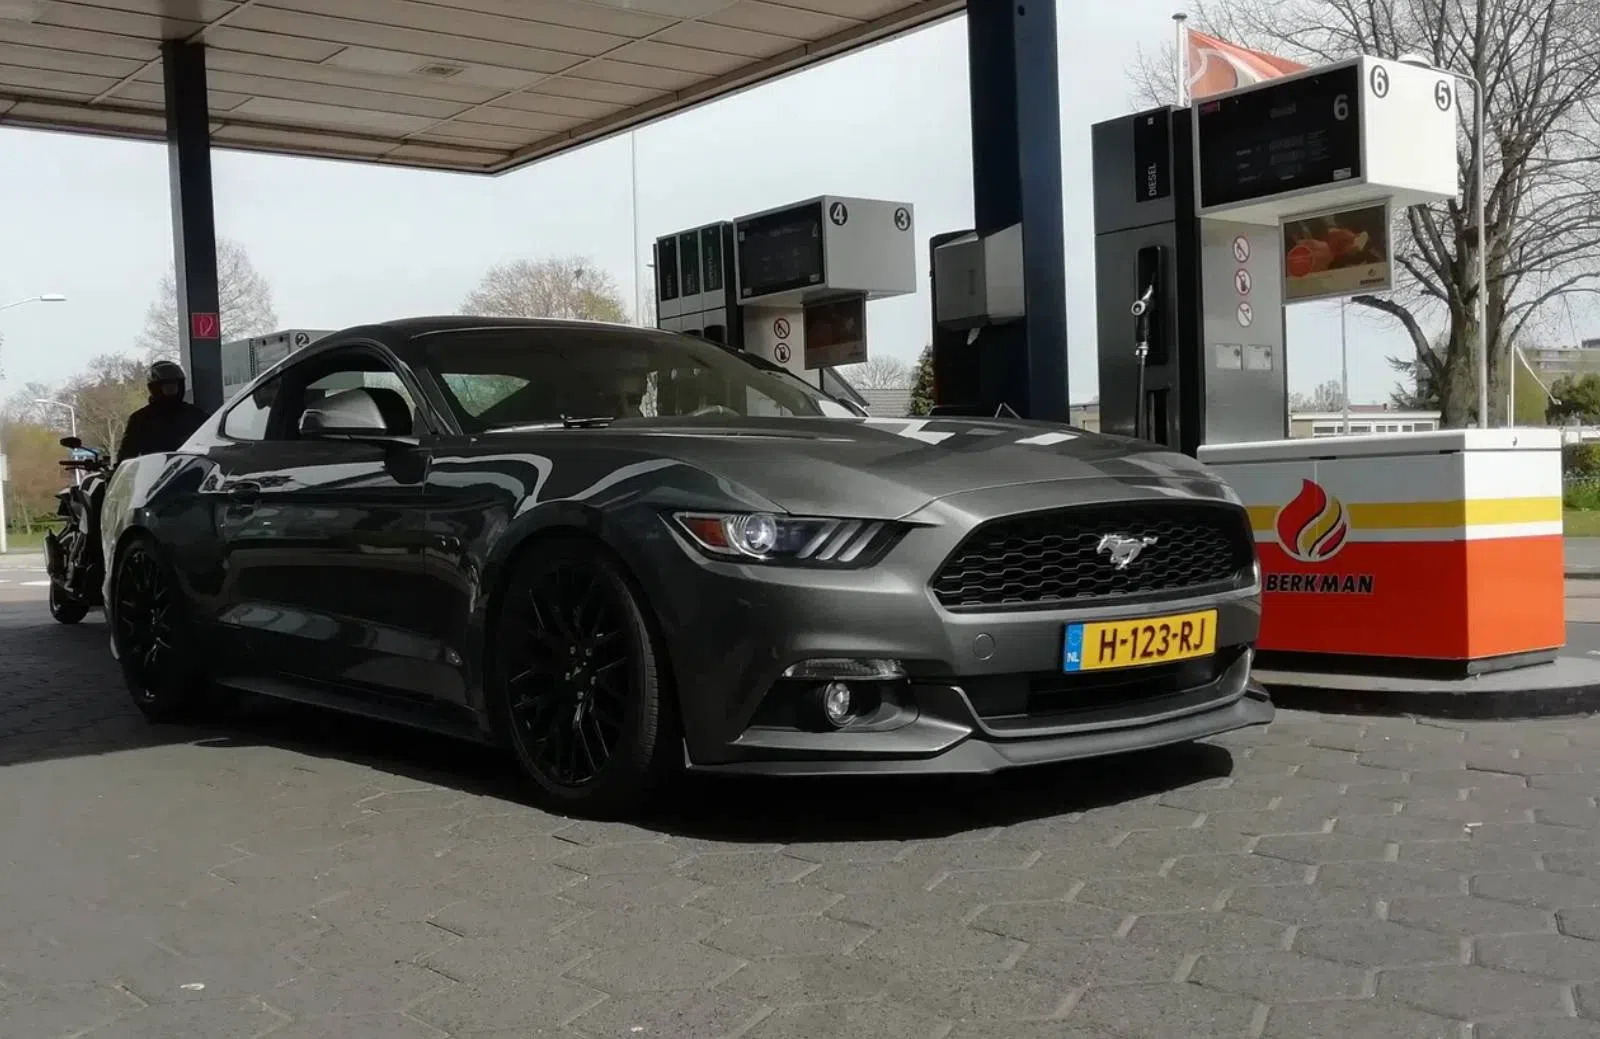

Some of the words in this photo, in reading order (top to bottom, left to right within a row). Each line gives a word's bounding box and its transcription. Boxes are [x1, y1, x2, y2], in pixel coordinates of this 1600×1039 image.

[1374, 66, 1387, 96] 6
[1437, 81, 1449, 109] 5
[1333, 93, 1349, 121] 6
[1148, 162, 1158, 197] DIESEL
[832, 203, 845, 225] 4
[896, 209, 908, 230] 3
[1266, 574, 1374, 593] BERKMAN
[1066, 652, 1080, 663] NL
[1099, 618, 1206, 663] H-123-RJ
